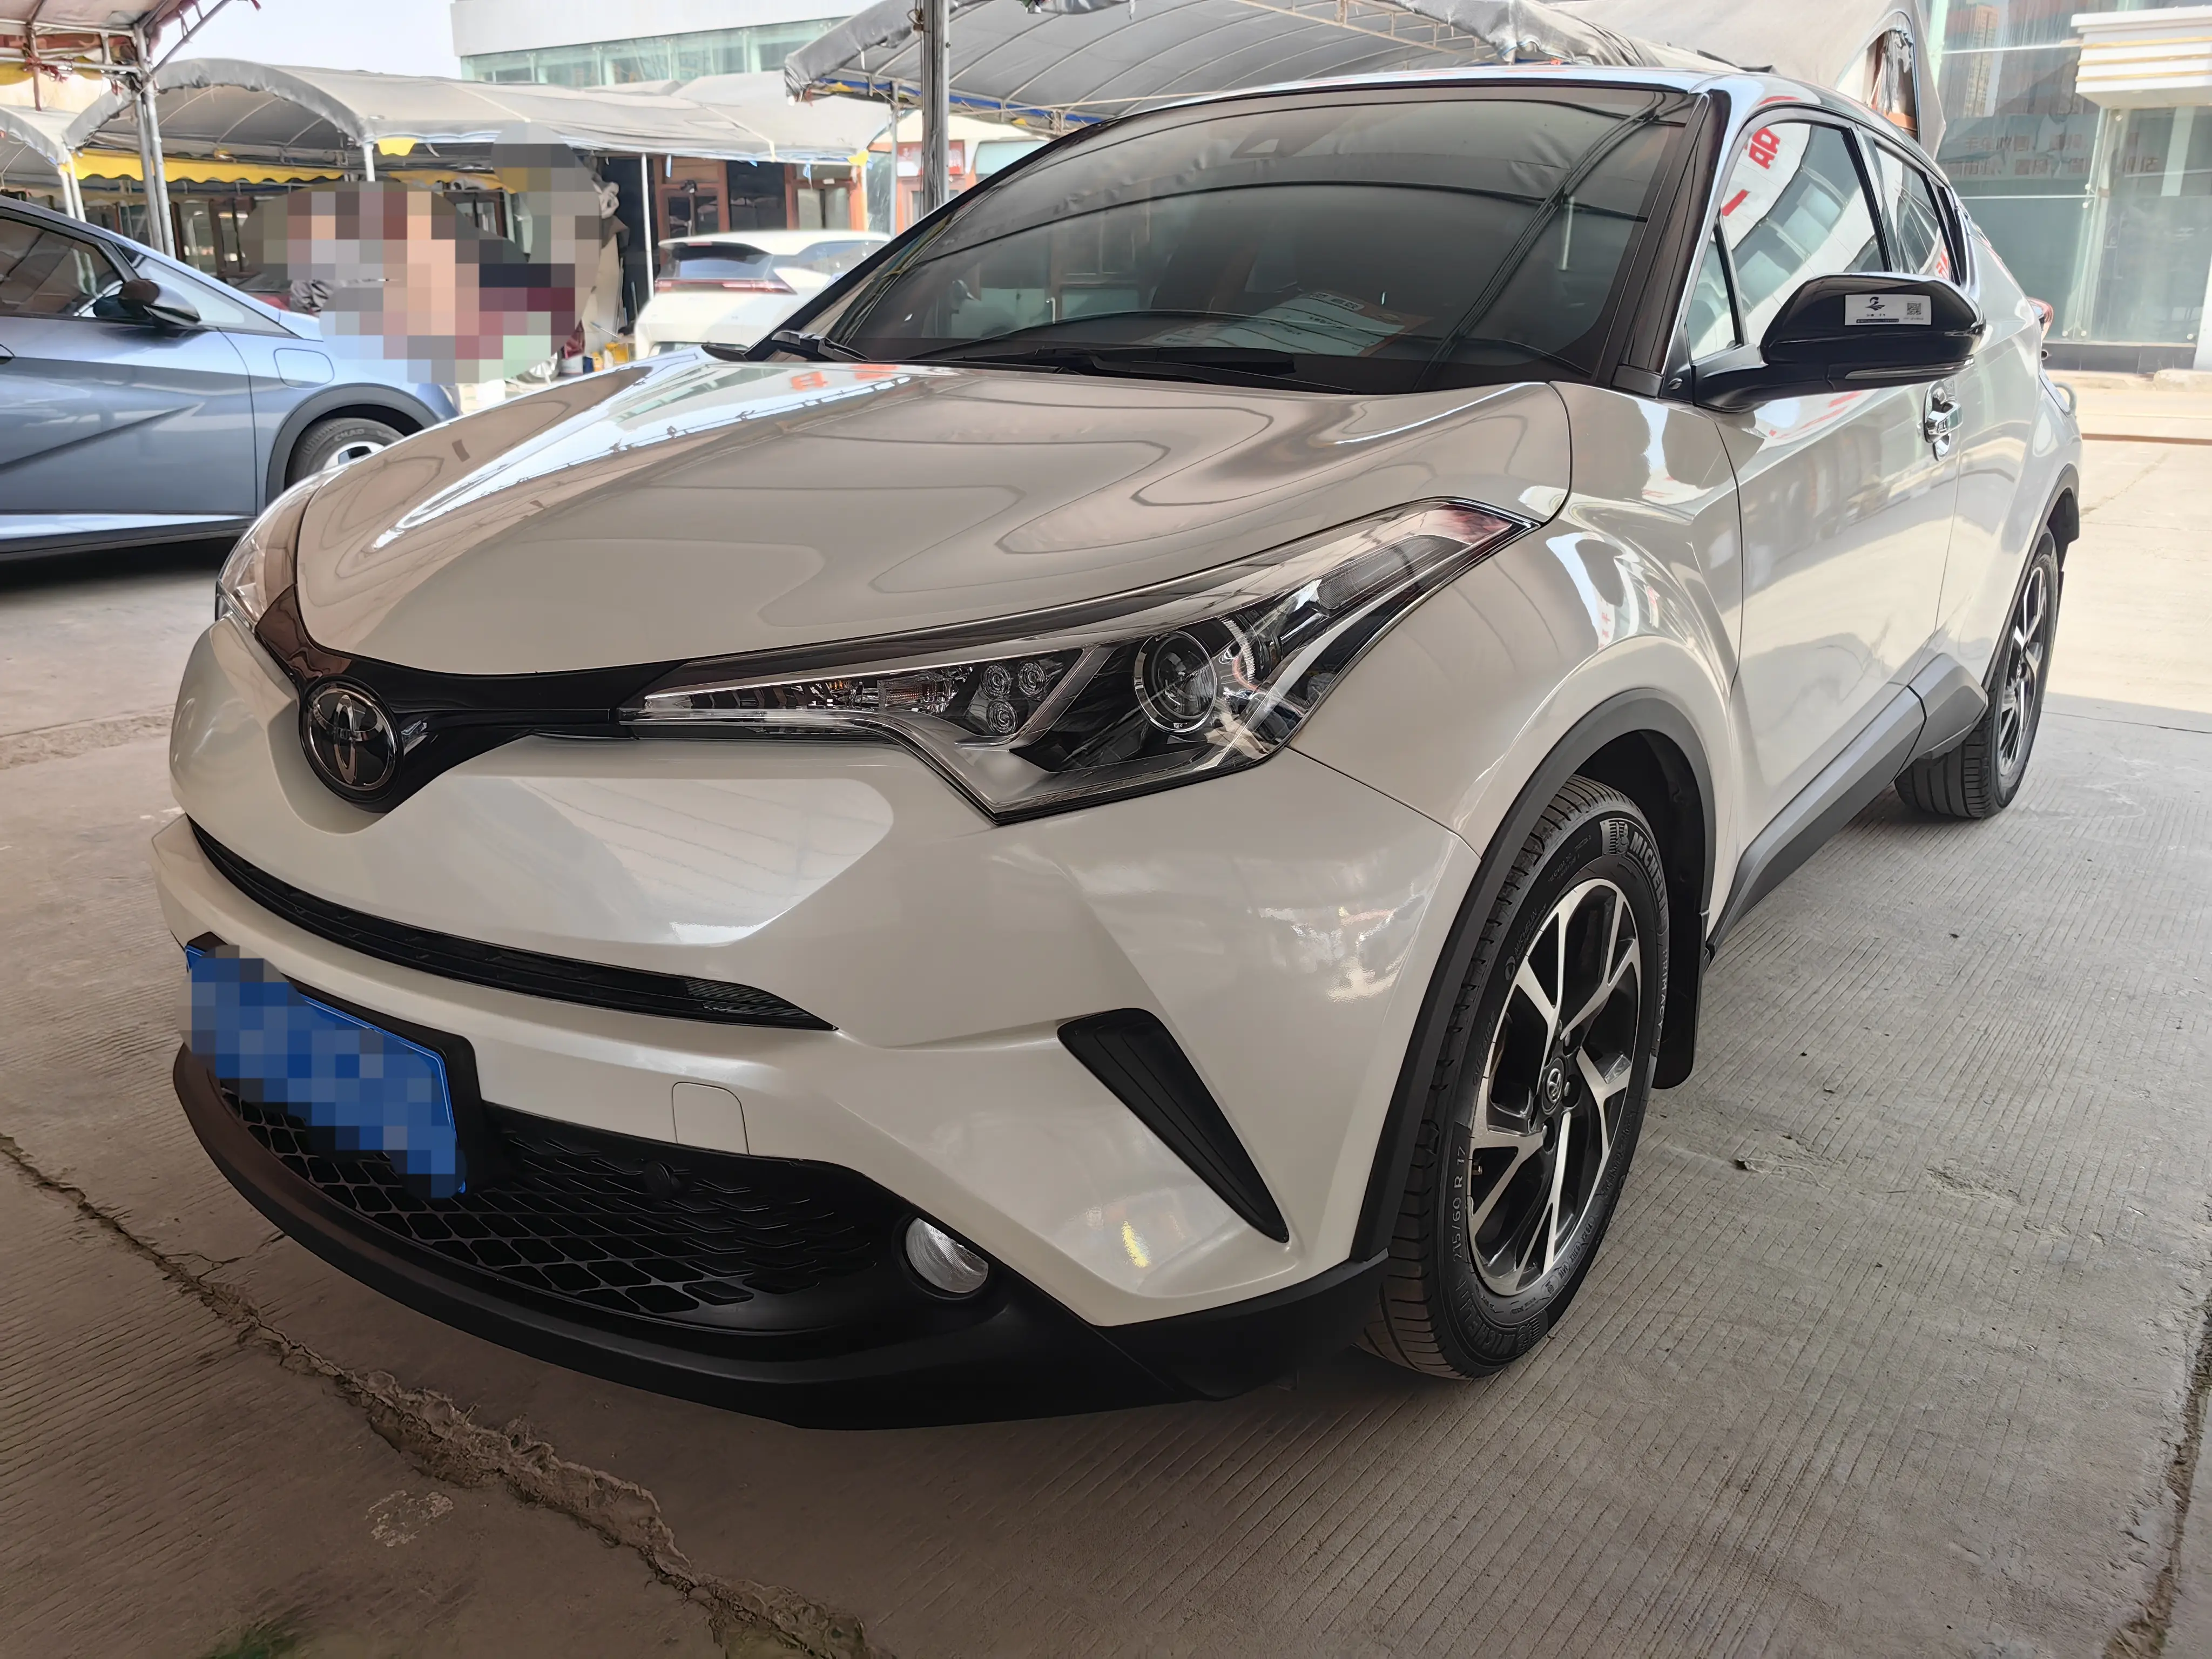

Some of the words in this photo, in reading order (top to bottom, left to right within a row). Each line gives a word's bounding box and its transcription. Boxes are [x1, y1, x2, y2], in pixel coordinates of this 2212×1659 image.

[1630, 831, 1669, 932] MICHELIN
[1457, 1145, 1466, 1165] 17
[1454, 1176, 1463, 1188] R
